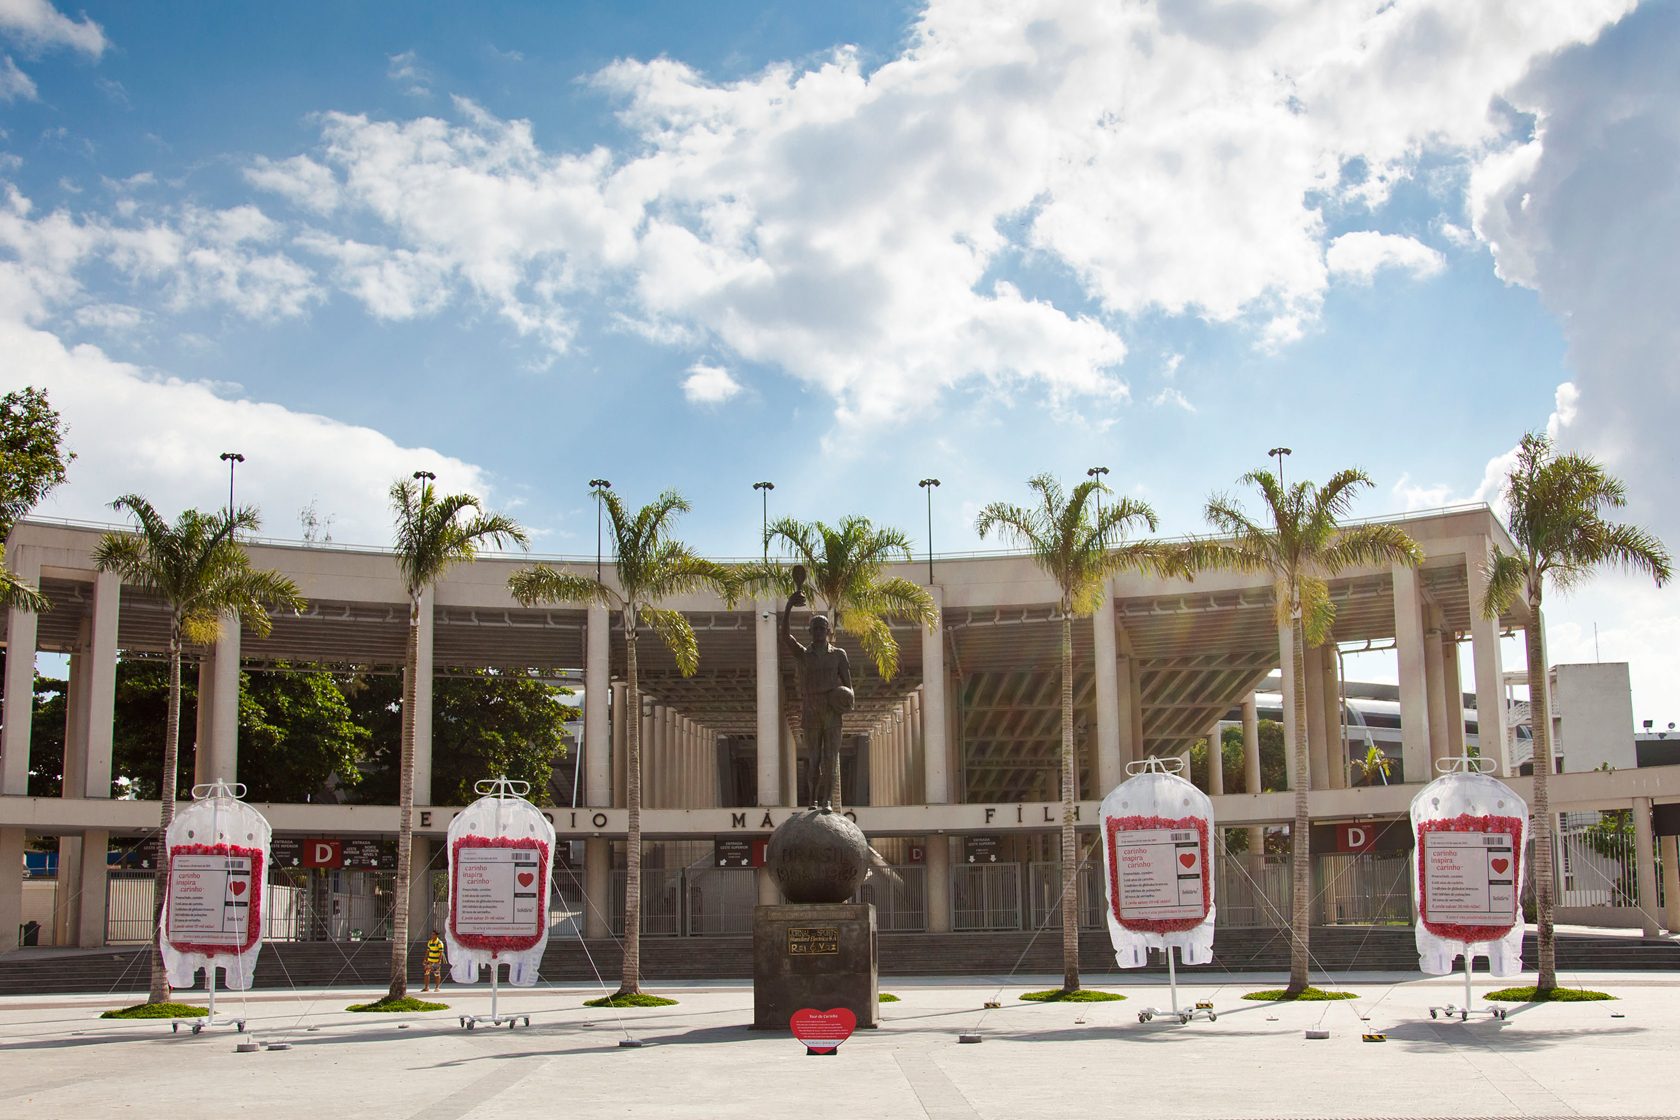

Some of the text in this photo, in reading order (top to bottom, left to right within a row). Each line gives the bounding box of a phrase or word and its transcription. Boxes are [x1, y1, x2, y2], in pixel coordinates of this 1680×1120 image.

[1347, 827, 1366, 848] D
[315, 843, 333, 863] D
[913, 848, 923, 860] D
[1123, 847, 1147, 855] carinho
